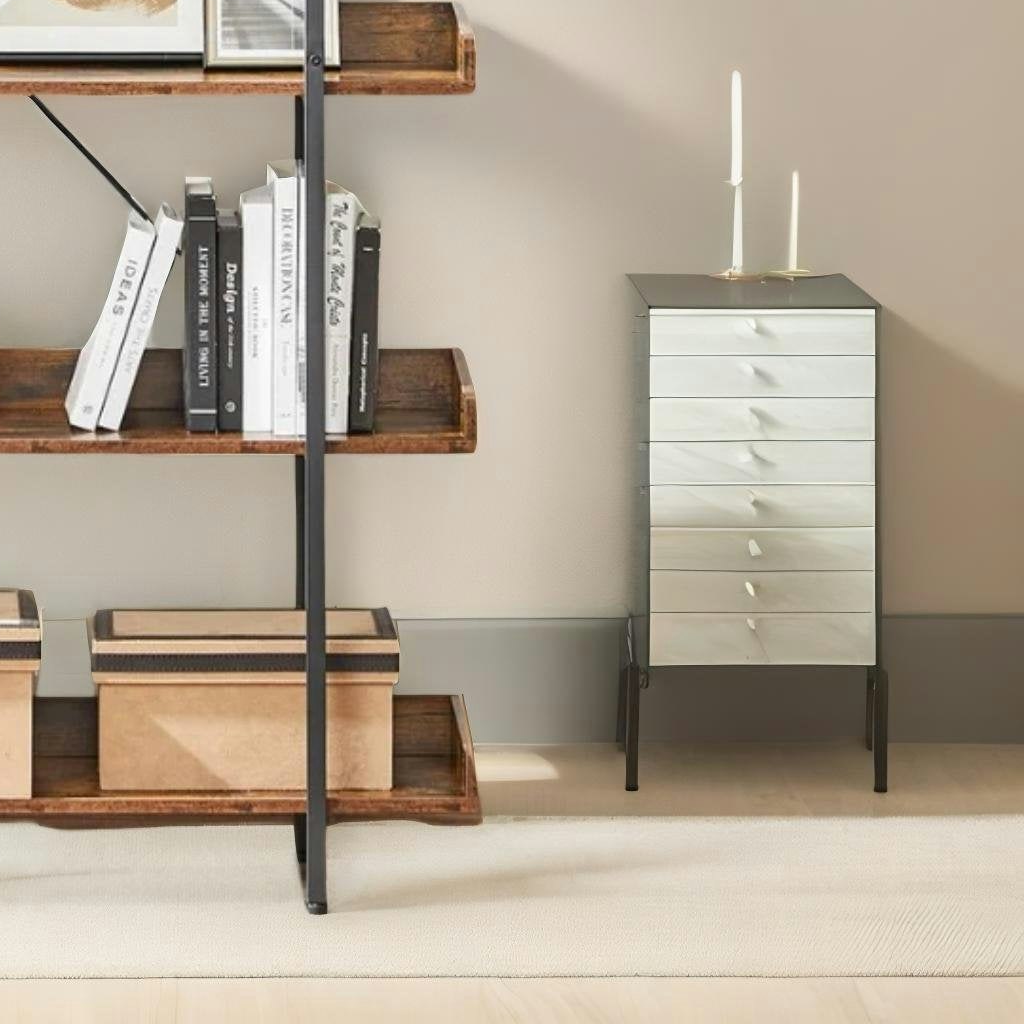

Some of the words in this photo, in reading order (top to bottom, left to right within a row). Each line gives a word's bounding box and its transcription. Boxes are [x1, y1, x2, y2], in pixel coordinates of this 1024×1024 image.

[333, 202, 349, 217] The
[112, 259, 138, 316] IDEAS
[198, 244, 210, 296] MOMENT
[222, 262, 238, 313] Design
[198, 301, 209, 326] THE
[198, 330, 209, 342] IN
[198, 347, 209, 387] LIVING
